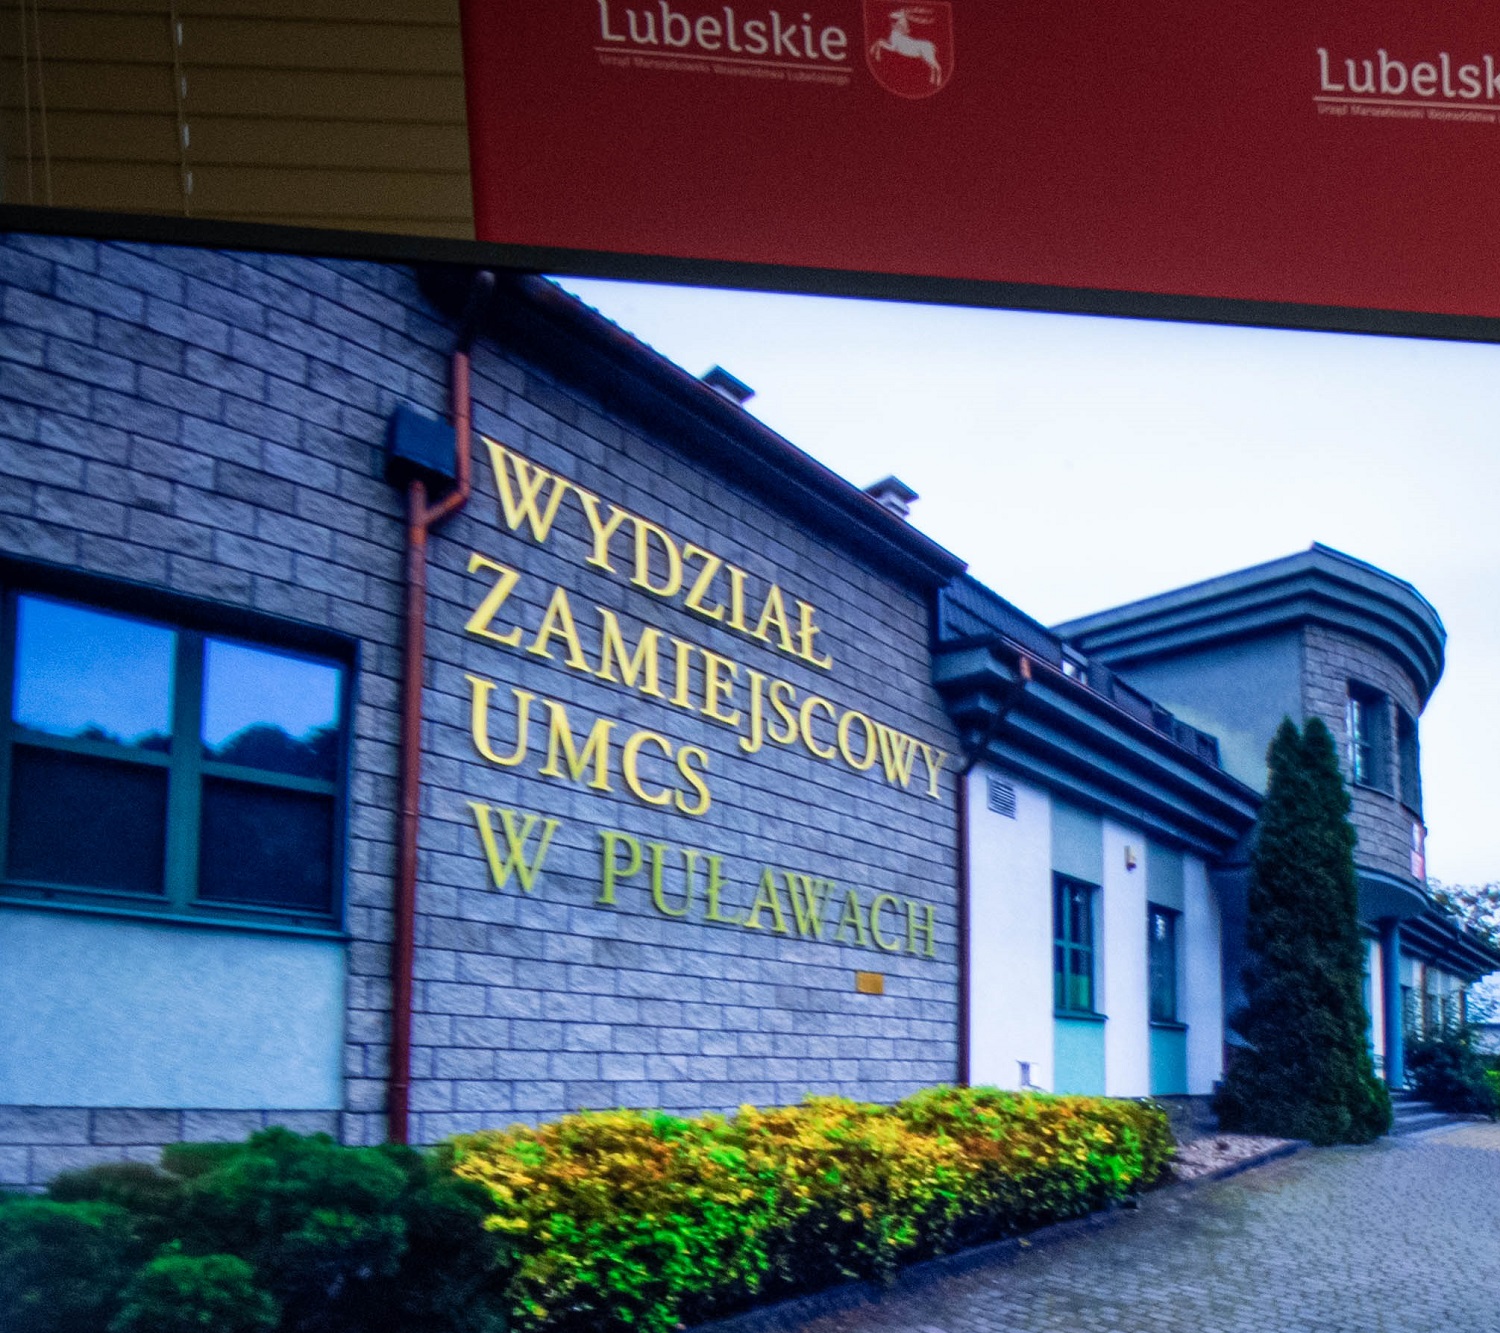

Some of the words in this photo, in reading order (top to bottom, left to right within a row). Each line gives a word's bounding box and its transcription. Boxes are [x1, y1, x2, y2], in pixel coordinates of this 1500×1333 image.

[597, 0, 847, 60] Lubelskie
[481, 436, 833, 671] WYDZIAŁ
[464, 553, 948, 799] ZAMIEJSCOWY
[464, 674, 712, 816] UMCS
[466, 801, 560, 893] W
[598, 829, 936, 957] PUŁAWACH
